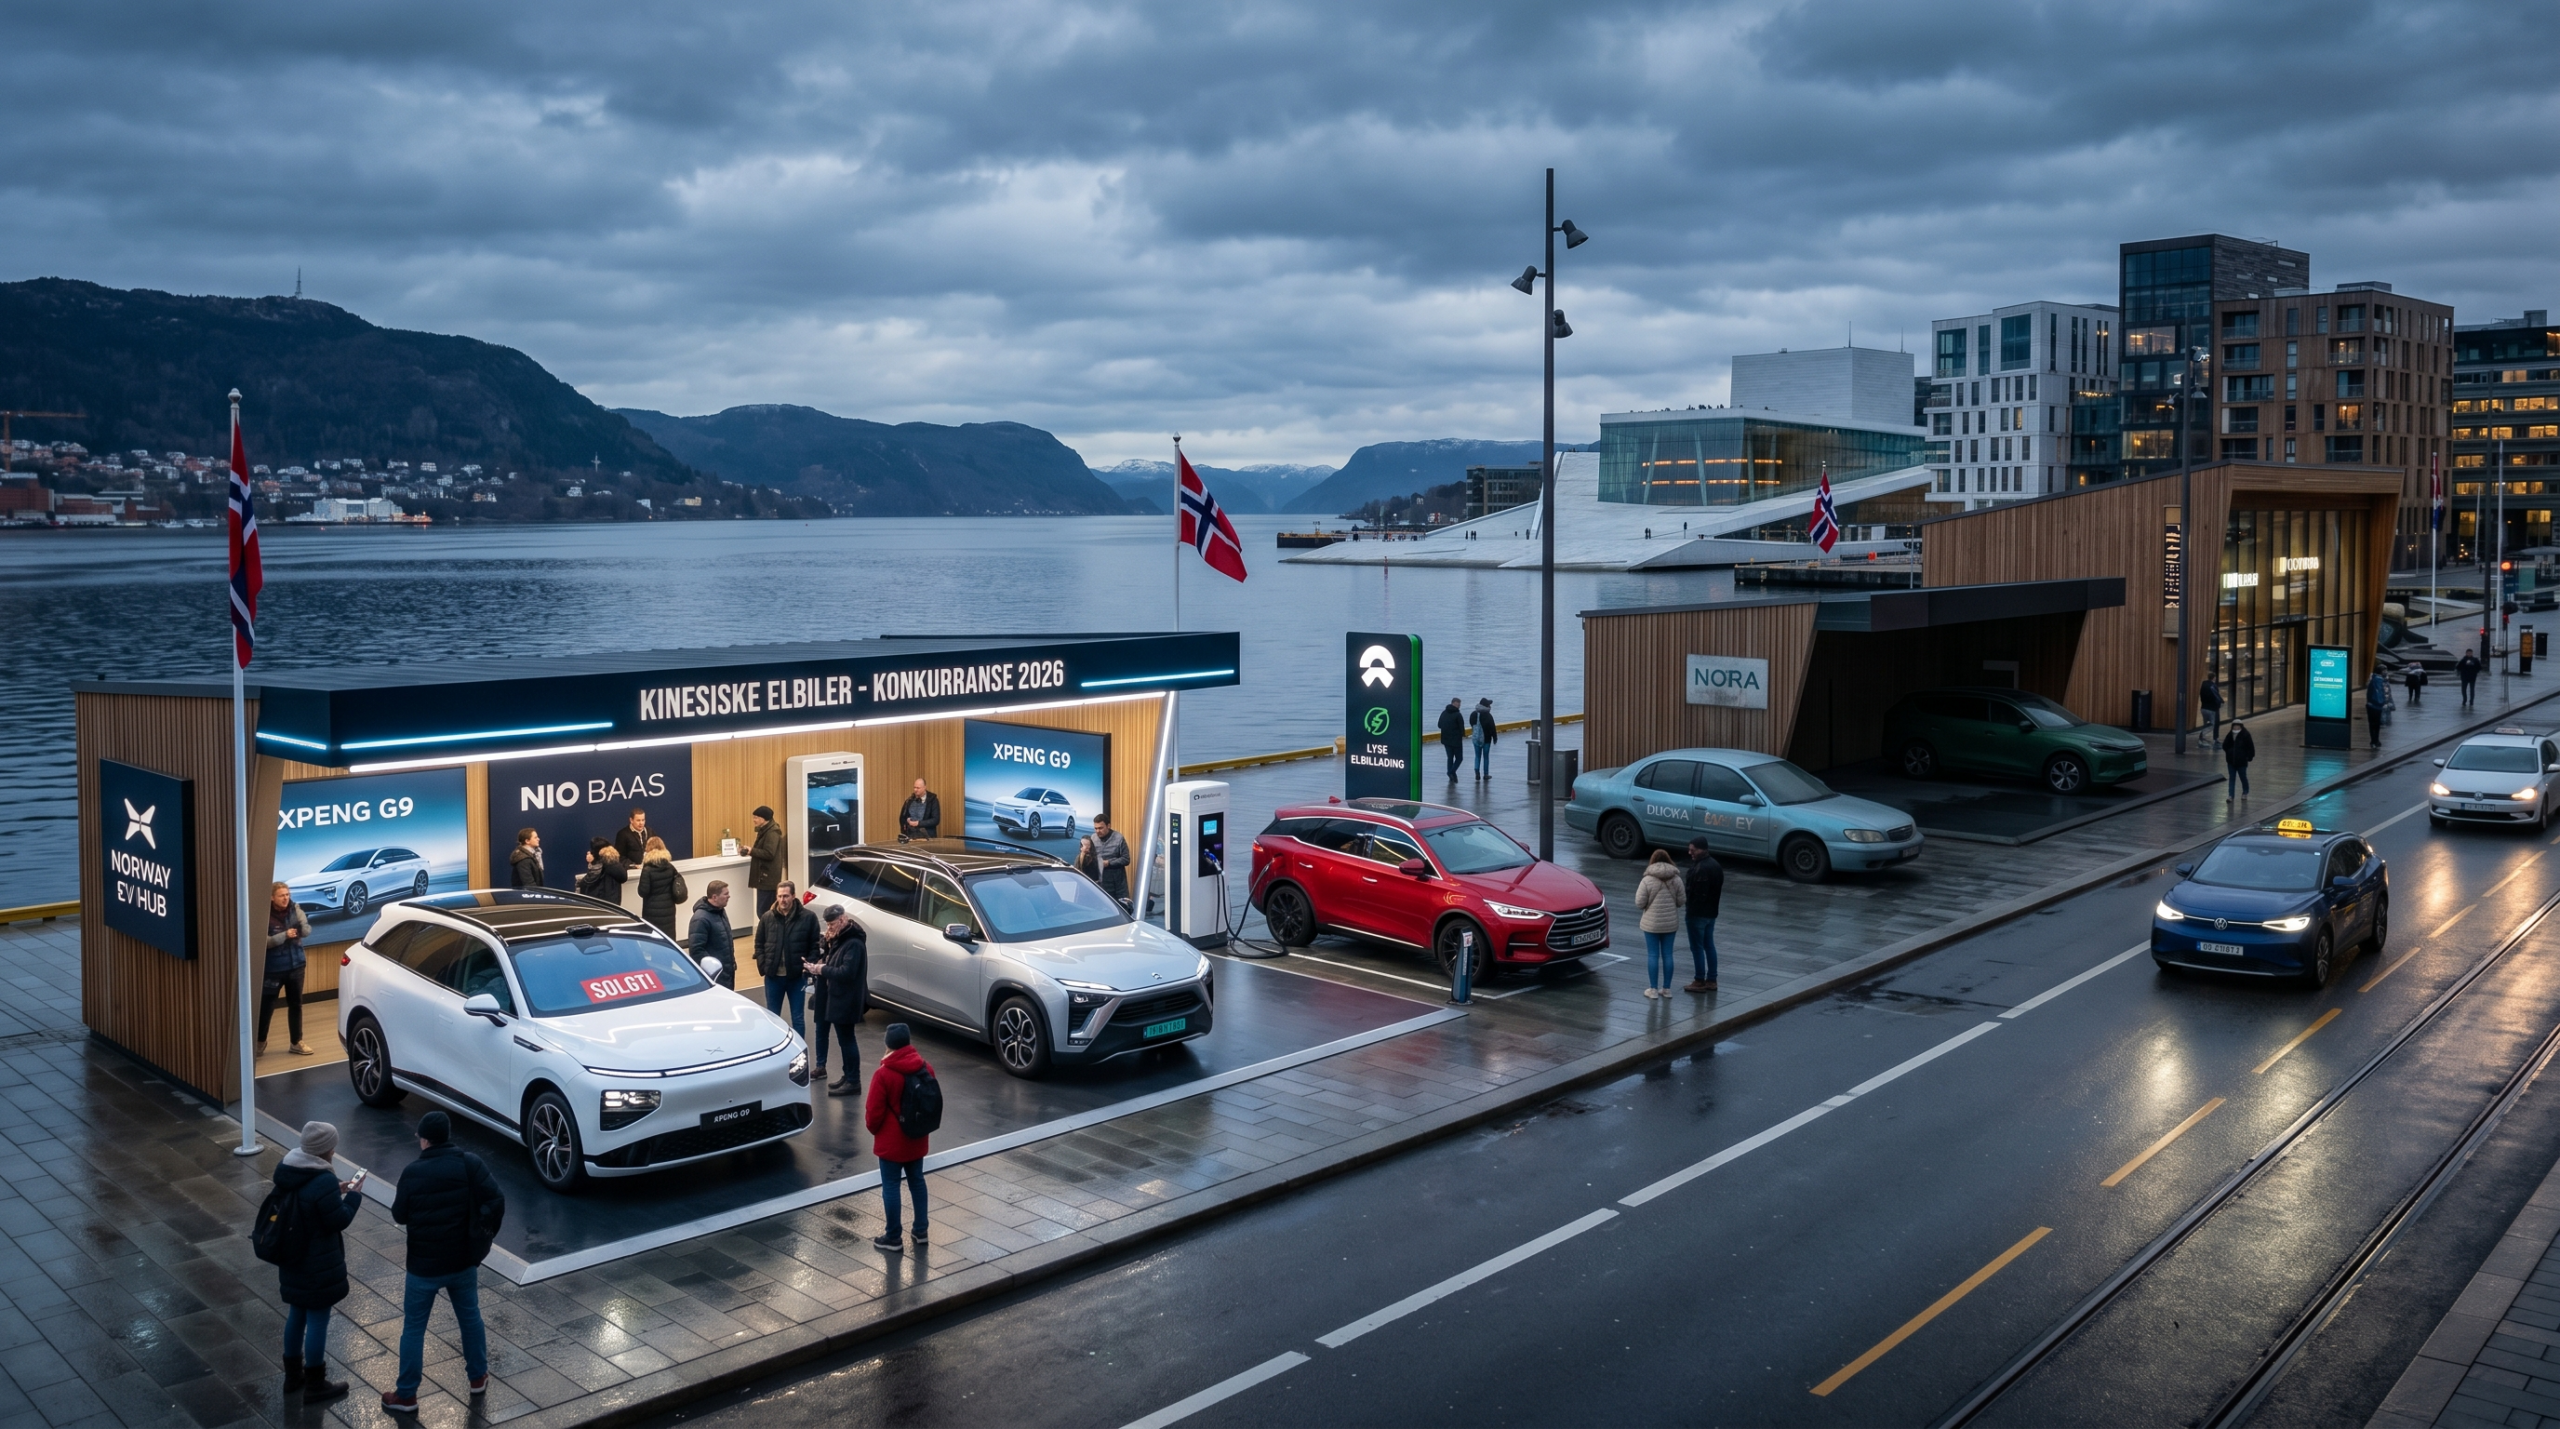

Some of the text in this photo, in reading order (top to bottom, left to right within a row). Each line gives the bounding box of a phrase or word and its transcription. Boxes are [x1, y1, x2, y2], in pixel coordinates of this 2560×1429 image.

[640, 659, 1064, 721] KINESISKE ELBILER - KONKURRANSE 2026
[1695, 667, 1760, 690] NORA
[993, 742, 1071, 770] XPENG G9
[1350, 754, 1404, 769] ELBILLADING
[1366, 743, 1388, 755] LYSE
[520, 772, 665, 812] NIO BAAS
[278, 796, 414, 831] XPENG G9
[111, 849, 171, 890] NORWAY
[117, 880, 167, 917] EV HUB
[589, 973, 658, 999] SOLGT!
